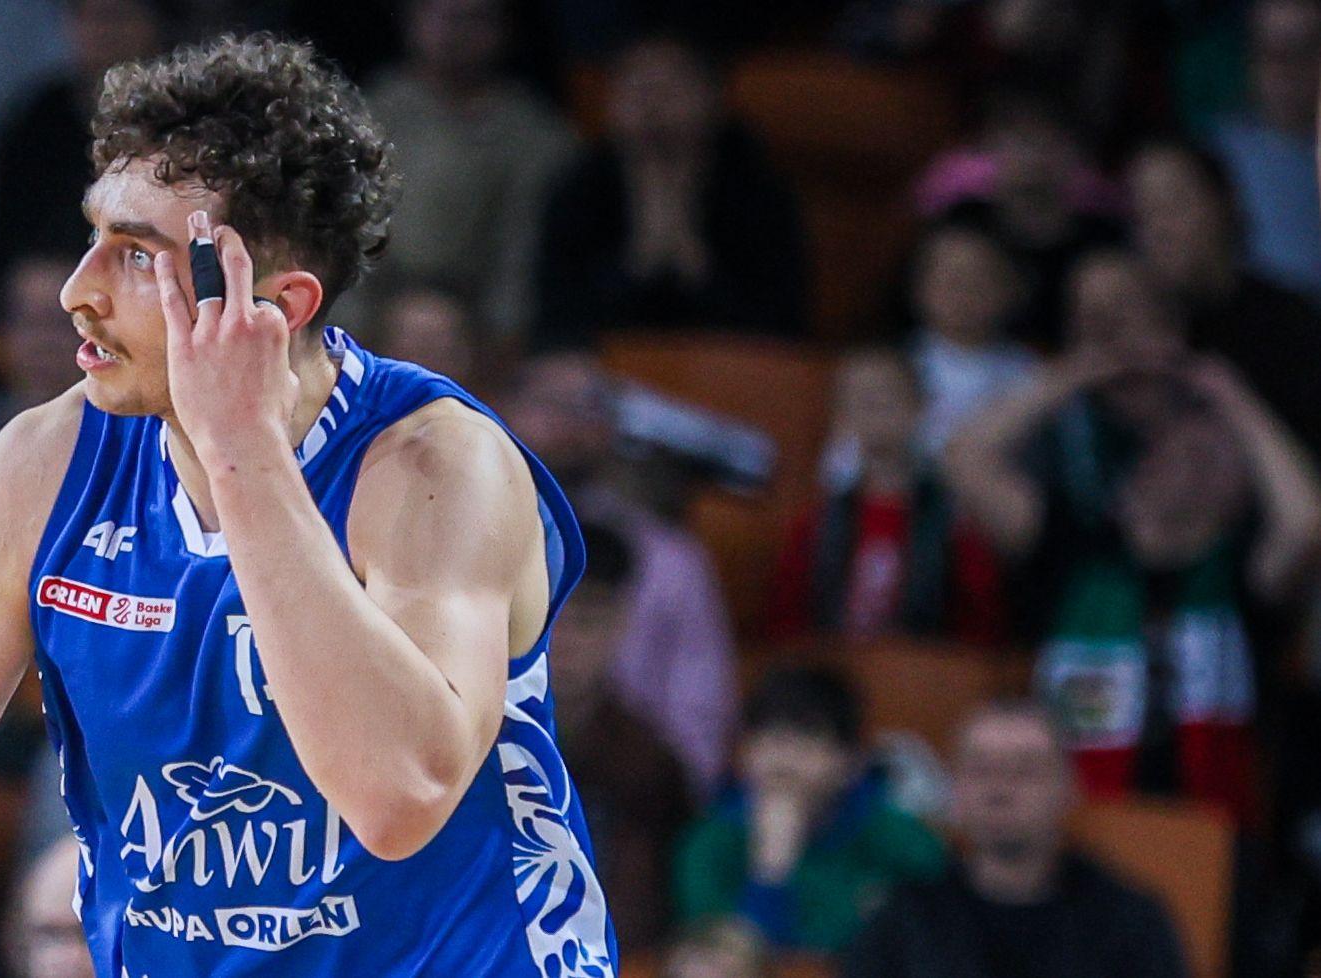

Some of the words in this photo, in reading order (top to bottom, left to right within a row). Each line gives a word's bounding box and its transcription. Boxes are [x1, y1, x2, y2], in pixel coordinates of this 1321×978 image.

[45, 584, 103, 615] ORLEN
[134, 614, 161, 628] Liga
[120, 774, 345, 893] Anwil
[123, 896, 215, 942] RUPA
[227, 901, 350, 944] ORLEN
